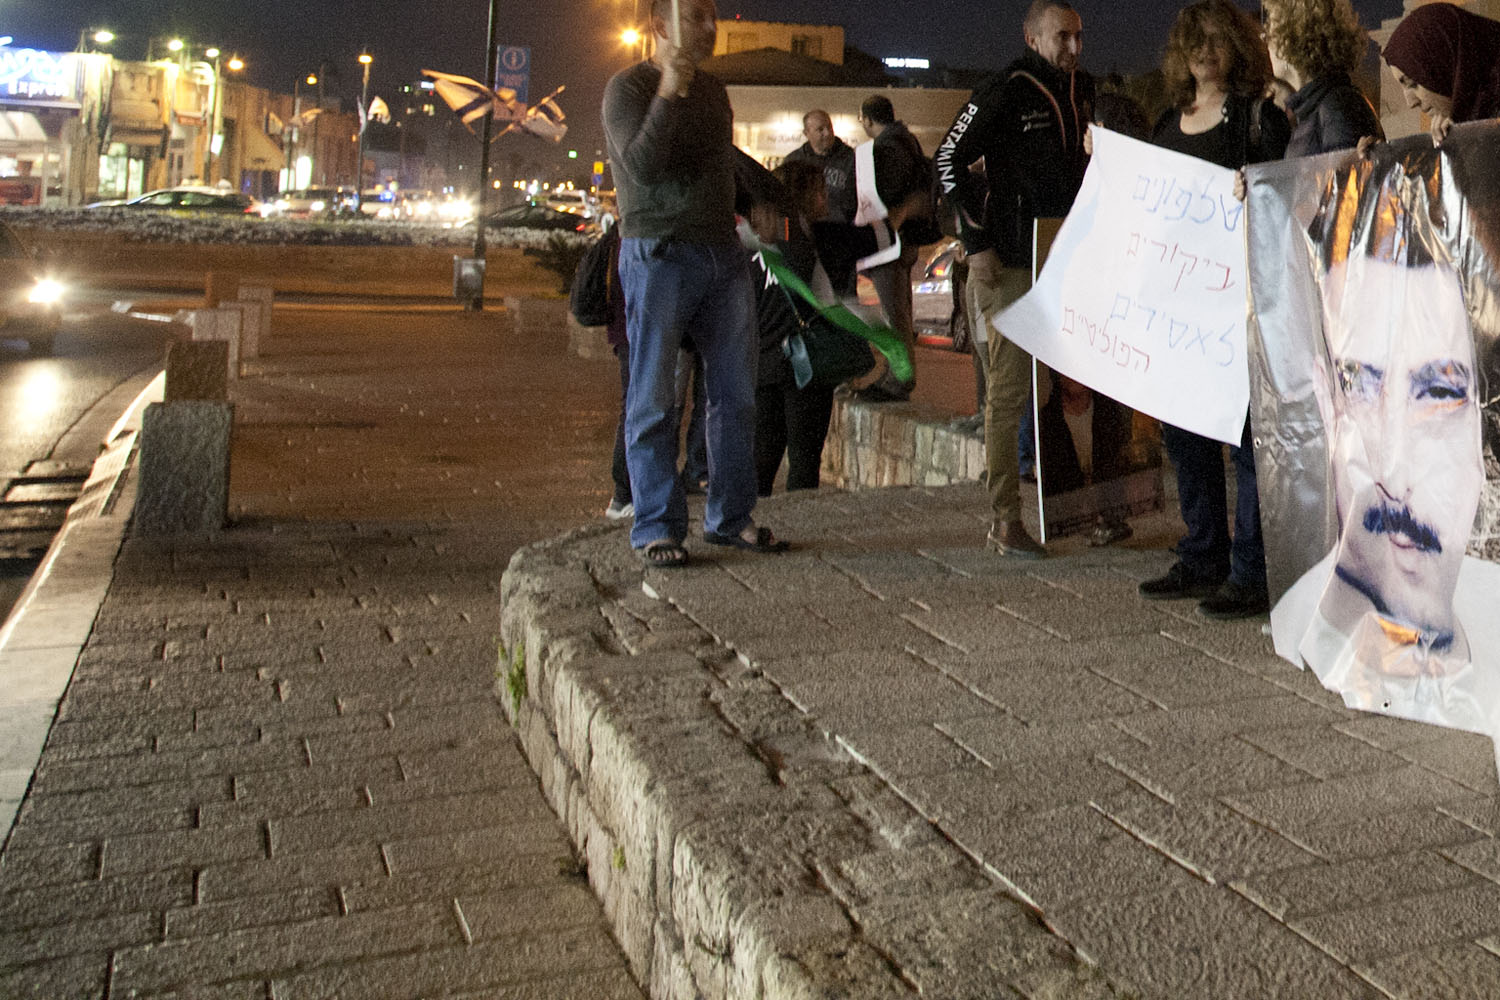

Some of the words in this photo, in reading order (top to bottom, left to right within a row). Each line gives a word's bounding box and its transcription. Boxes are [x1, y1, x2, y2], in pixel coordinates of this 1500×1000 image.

[936, 102, 979, 194] PERTAMINA
[1132, 174, 1243, 232] טלפונים
[1126, 231, 1236, 293] ביקורים
[1110, 292, 1236, 368] לאסירים
